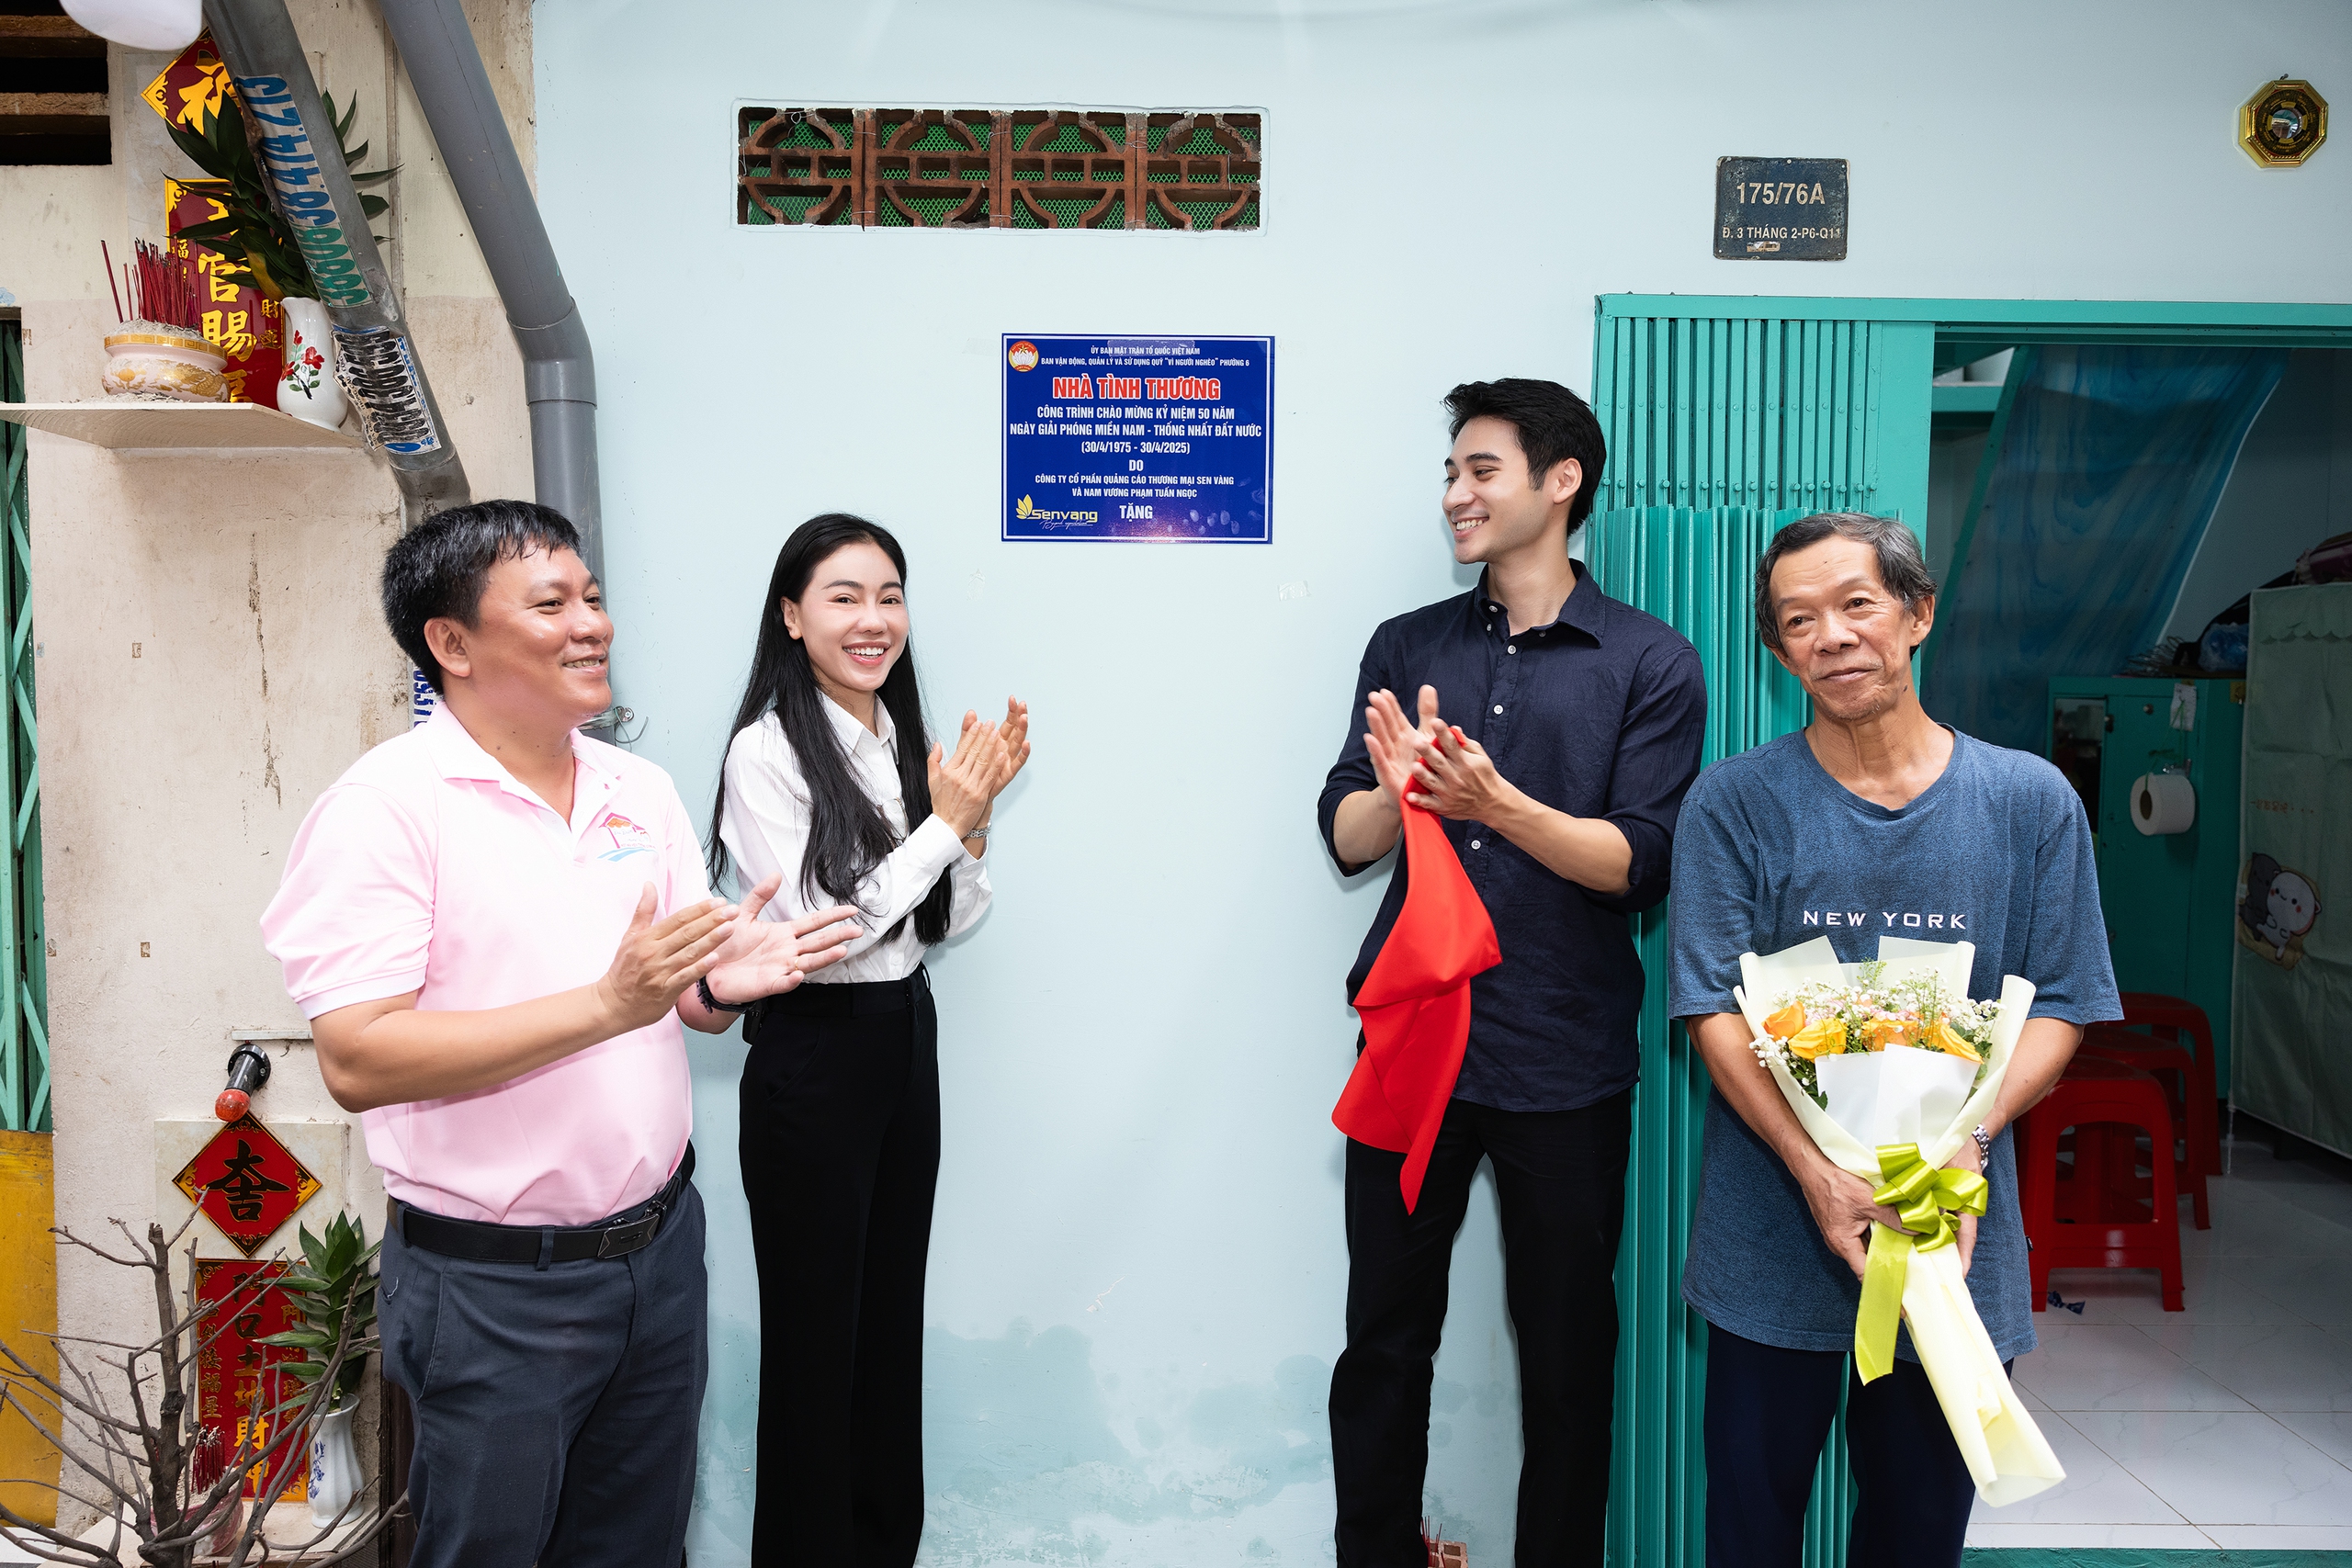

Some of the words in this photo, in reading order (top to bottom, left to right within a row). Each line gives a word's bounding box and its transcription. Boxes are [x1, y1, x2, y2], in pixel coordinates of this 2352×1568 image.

[1736, 182, 1826, 205] 175/76A
[1722, 226, 1734, 239] Đ.
[1736, 227, 1744, 239] 3
[1747, 223, 1788, 239] THÁNG
[1791, 227, 1841, 240] 2-P6-Q11
[1171, 345, 1184, 356] VIỆT
[1185, 347, 1201, 355] NAM
[1055, 356, 1068, 367] VẬN
[1088, 356, 1105, 366] QUẢN
[1106, 356, 1114, 366] LÝ
[1114, 356, 1124, 366] VÀ
[1134, 358, 1150, 367] DỤNG
[1052, 373, 1093, 399] NHÀ
[1096, 373, 1141, 399] TÌNH
[1145, 376, 1221, 400] THƯƠNG
[1037, 404, 1063, 418] CÔNG
[1066, 405, 1094, 418] TRÌNH
[1096, 405, 1122, 418] CHÀO
[1125, 405, 1153, 419] MỪNG
[1156, 404, 1169, 419] KỶ
[1170, 406, 1195, 422] NIỆM
[1198, 409, 1210, 419] 50
[1213, 406, 1235, 420] NĂM
[1010, 421, 1035, 434] NGÀY
[1038, 420, 1057, 435] GIẢI
[1060, 422, 1092, 435] PHÓNG
[1095, 421, 1120, 435] MIỀN
[1122, 424, 1145, 435] NAM
[1154, 421, 1185, 436] THỐNG
[1187, 422, 1213, 436] NHẤT
[1215, 422, 1233, 436] ĐẤT
[1235, 423, 1261, 437] NƯỚC
[1081, 441, 1132, 454] (30/4/1975
[1140, 442, 1191, 455] 30/4/2025)
[1129, 459, 1144, 471] DO
[1035, 473, 1057, 483] CÔNG
[1057, 475, 1067, 483] TY
[1069, 472, 1080, 483] CỔ
[1103, 473, 1129, 485] QUẢNG
[1131, 474, 1147, 484] CÁO
[1148, 476, 1178, 485] THƯƠNG
[1180, 477, 1195, 487] MẠI
[1196, 477, 1212, 485] SEN
[1214, 475, 1235, 485] VÀNG
[1072, 487, 1082, 497] VÀ
[1084, 489, 1102, 497] NAM
[1103, 488, 1129, 497] VƯƠNG
[1131, 489, 1153, 499] PHẠM
[1155, 486, 1175, 498] TUẤN
[1176, 489, 1198, 500] NGỌC
[1026, 509, 1098, 523] Senvang
[1119, 502, 1153, 523] TẶNG
[1804, 910, 1866, 927] NEW
[1883, 911, 1966, 930] YORK
